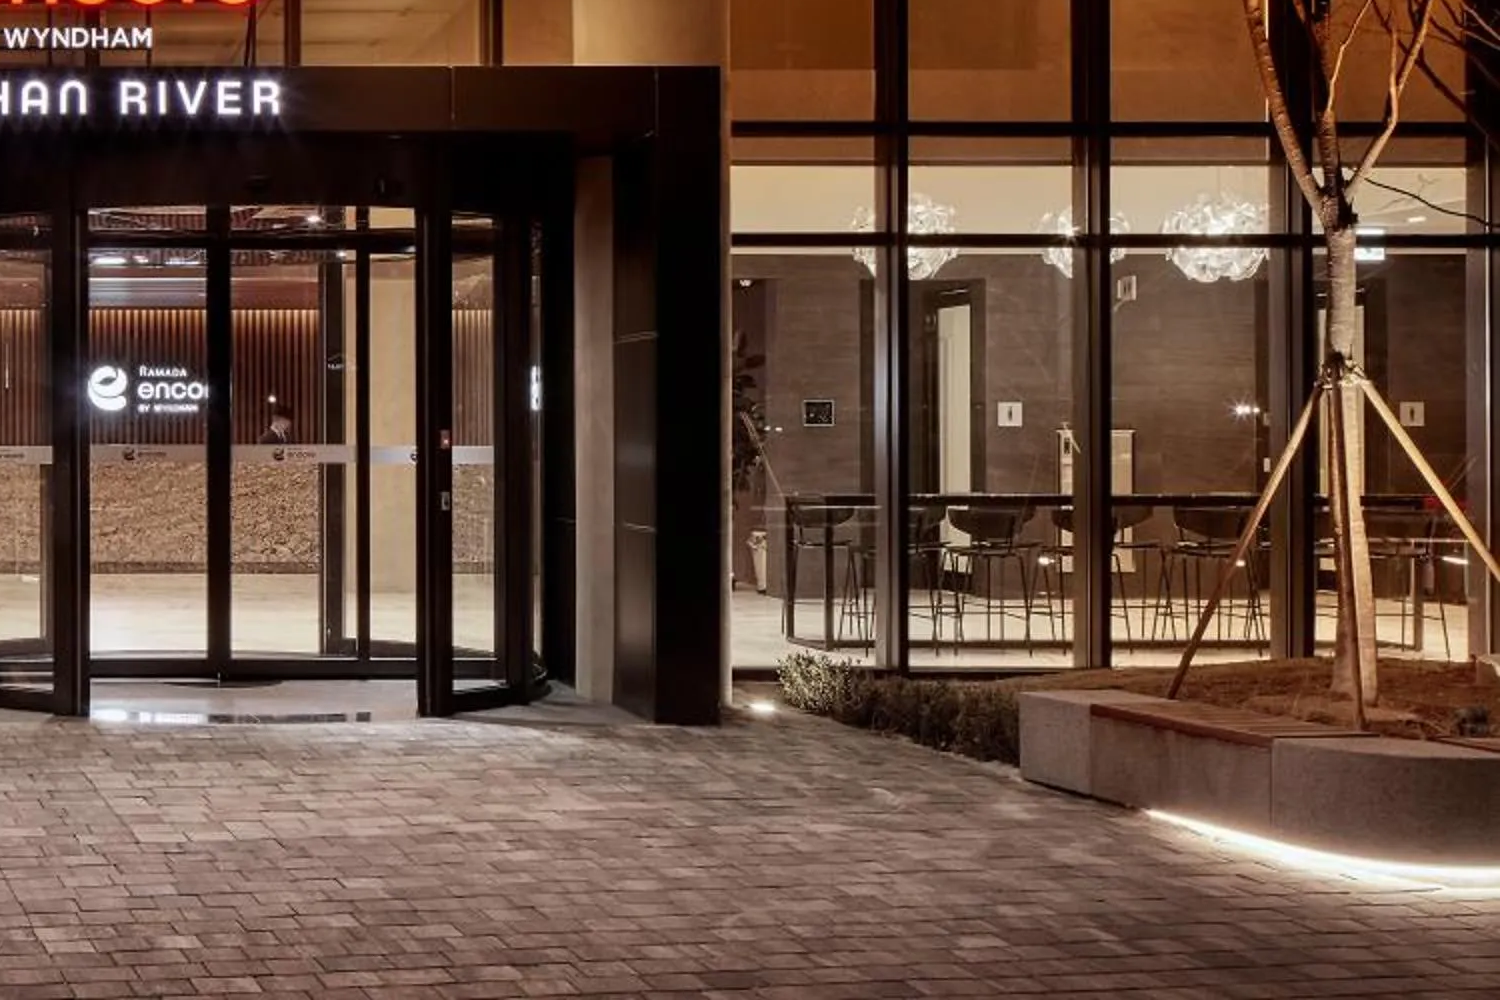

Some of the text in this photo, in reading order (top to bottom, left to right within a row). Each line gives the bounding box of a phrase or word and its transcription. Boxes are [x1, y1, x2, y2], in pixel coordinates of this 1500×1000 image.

[3, 27, 153, 49] WYNDHAM
[119, 79, 282, 115] RIVER
[137, 381, 209, 400] enco
